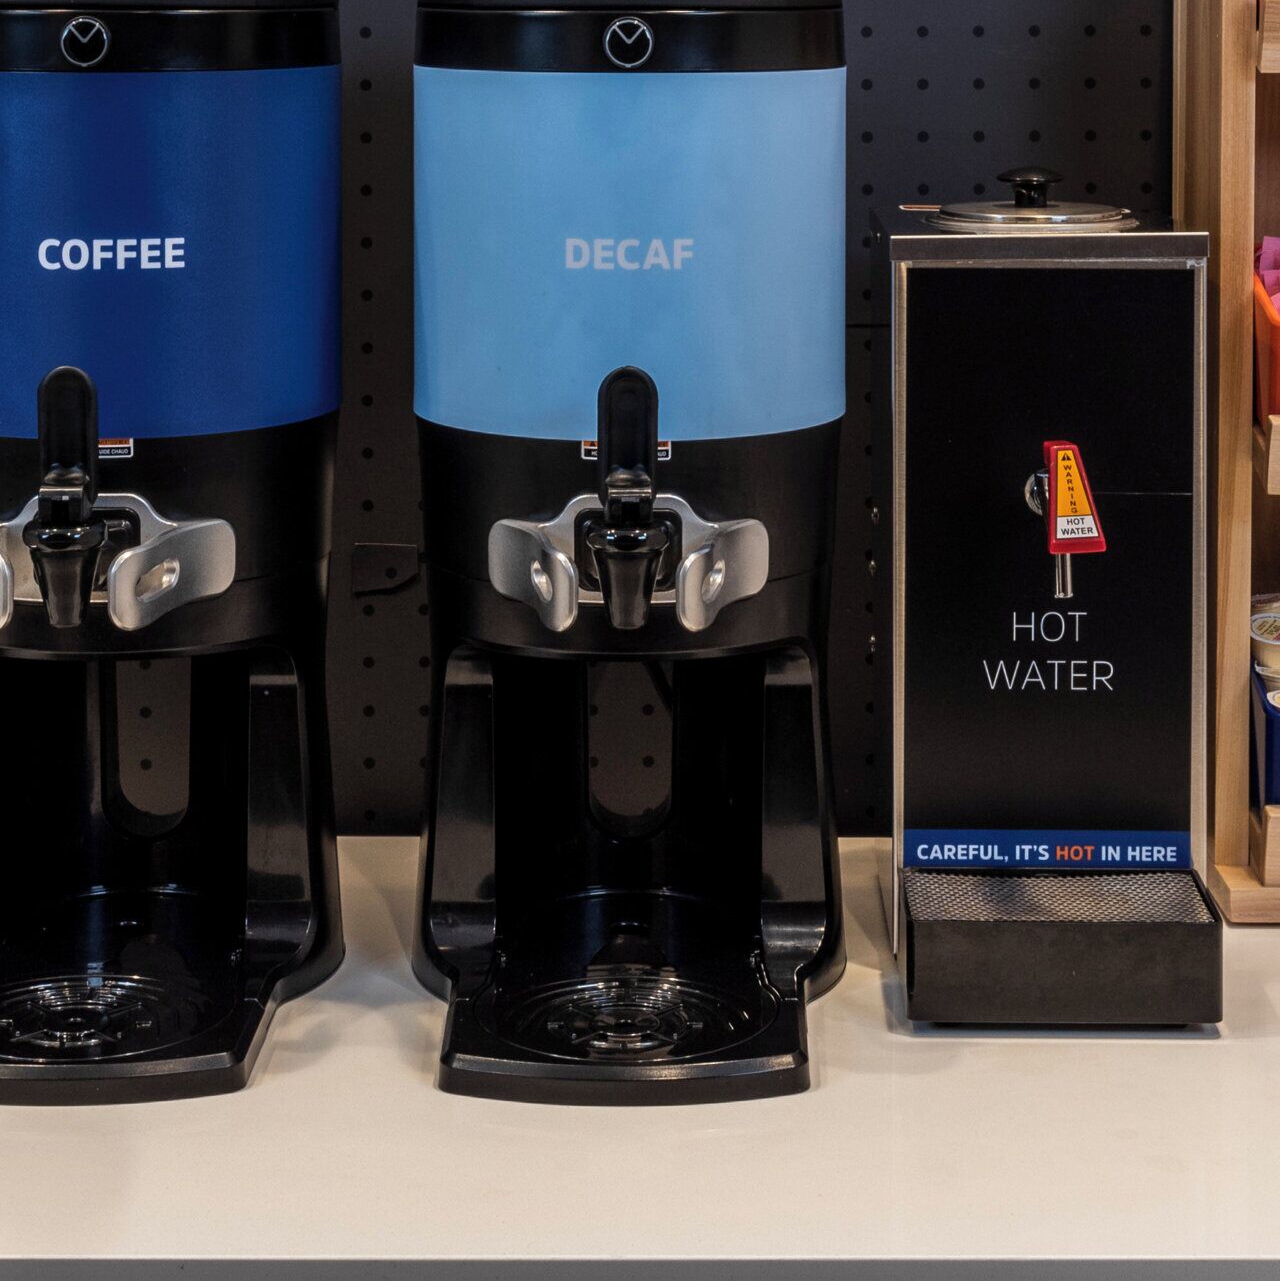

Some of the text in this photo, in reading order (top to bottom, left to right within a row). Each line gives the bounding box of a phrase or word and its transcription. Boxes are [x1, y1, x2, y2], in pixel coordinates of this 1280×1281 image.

[37, 237, 186, 270] COFFEE
[564, 238, 694, 271] DECAF
[1063, 464, 1078, 513] WARNING
[1061, 527, 1094, 536] WATER
[1066, 517, 1085, 525] HOT
[1012, 611, 1087, 643] HOT
[983, 660, 1114, 691] WATER
[917, 844, 1177, 863] CAREFUL, IT'S HOT IN HERE
